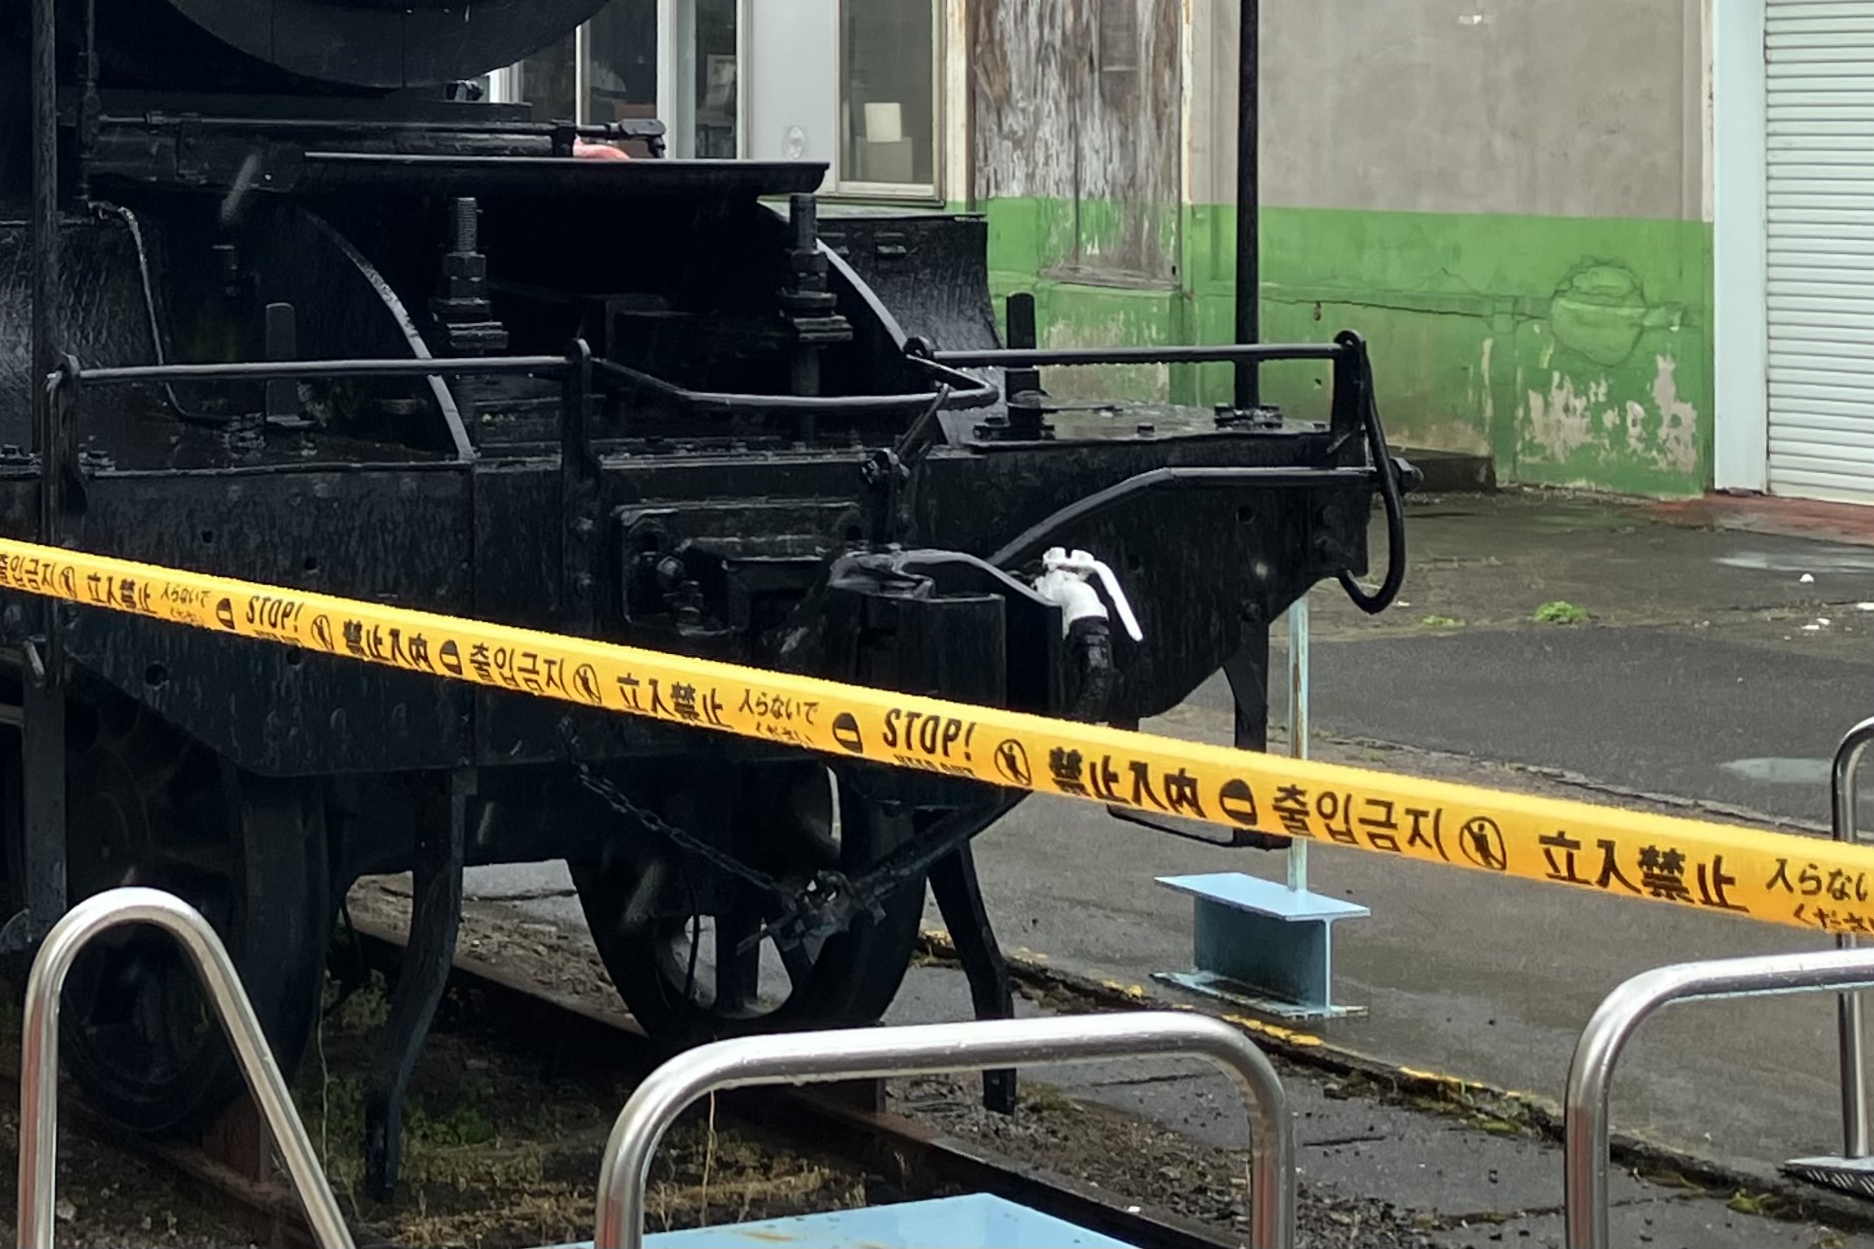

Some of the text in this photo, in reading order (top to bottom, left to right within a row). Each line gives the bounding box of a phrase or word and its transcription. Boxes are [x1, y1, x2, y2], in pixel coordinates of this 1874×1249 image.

[87, 572, 157, 614] 立入禁止
[246, 595, 305, 633] STOP!
[343, 618, 435, 672] 禁止入内
[469, 641, 573, 698] 출입금지
[616, 672, 734, 729] 立入禁止
[738, 688, 820, 726] 入らないで
[882, 708, 977, 762] STOP!
[1049, 746, 1207, 818] 禁止入内
[1271, 783, 1451, 862] 출입금지
[1538, 830, 1750, 913] 立入禁止
